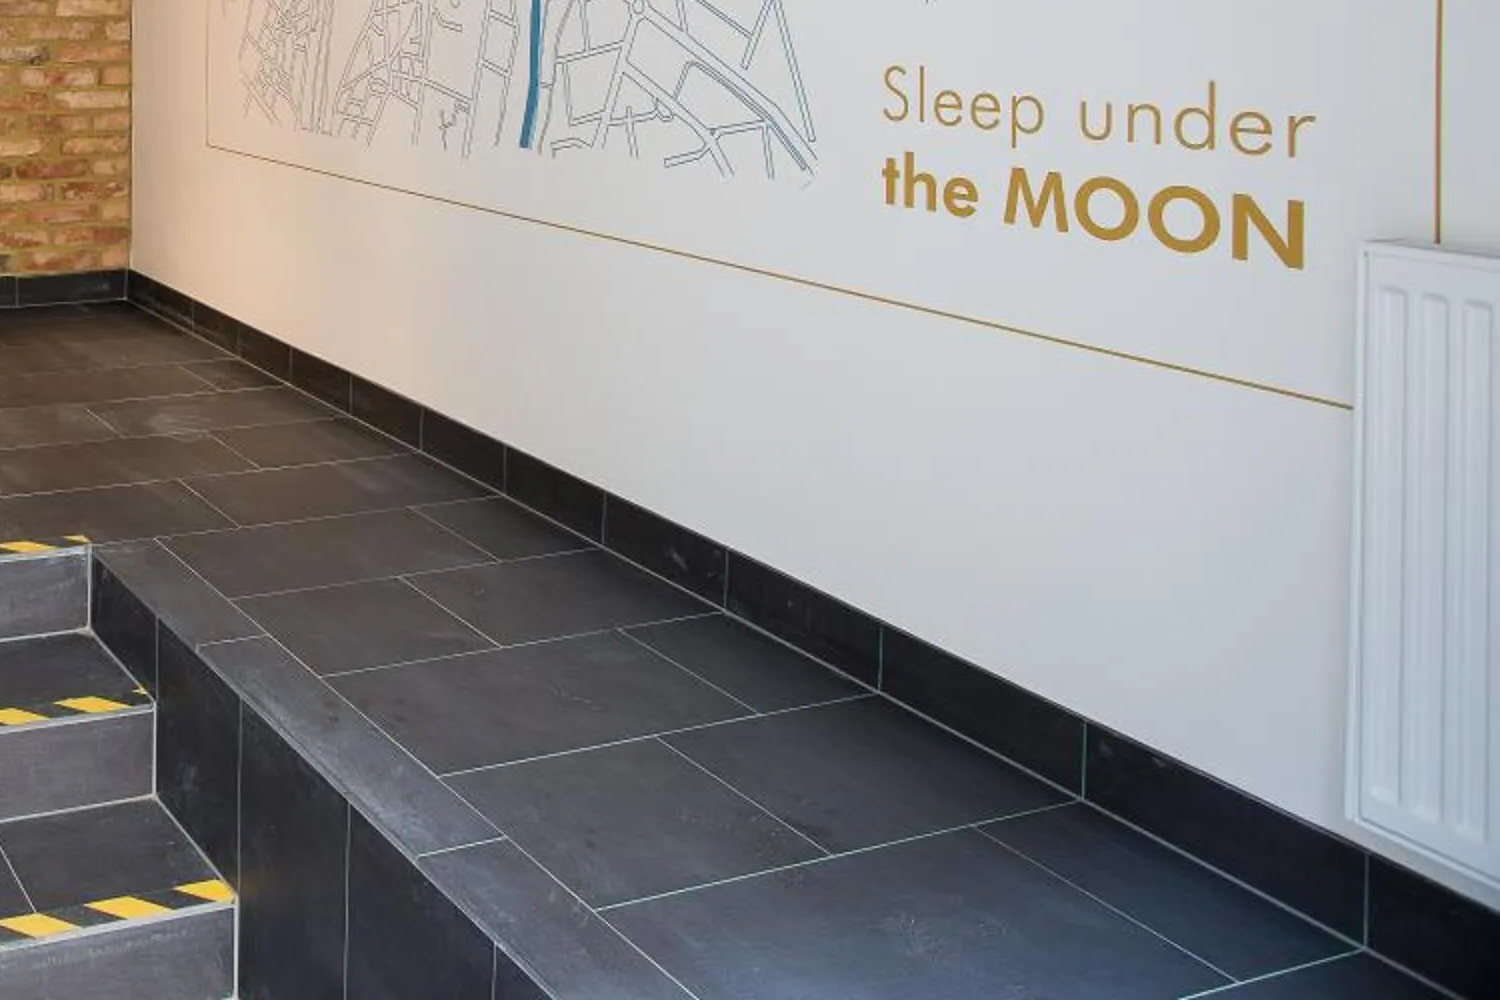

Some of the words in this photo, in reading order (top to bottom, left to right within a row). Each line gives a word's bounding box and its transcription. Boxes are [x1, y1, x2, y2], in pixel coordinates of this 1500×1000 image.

[883, 65, 1045, 148] Sleep
[1080, 80, 1316, 157] under
[881, 151, 979, 218] the
[1003, 167, 1305, 270] MOON
